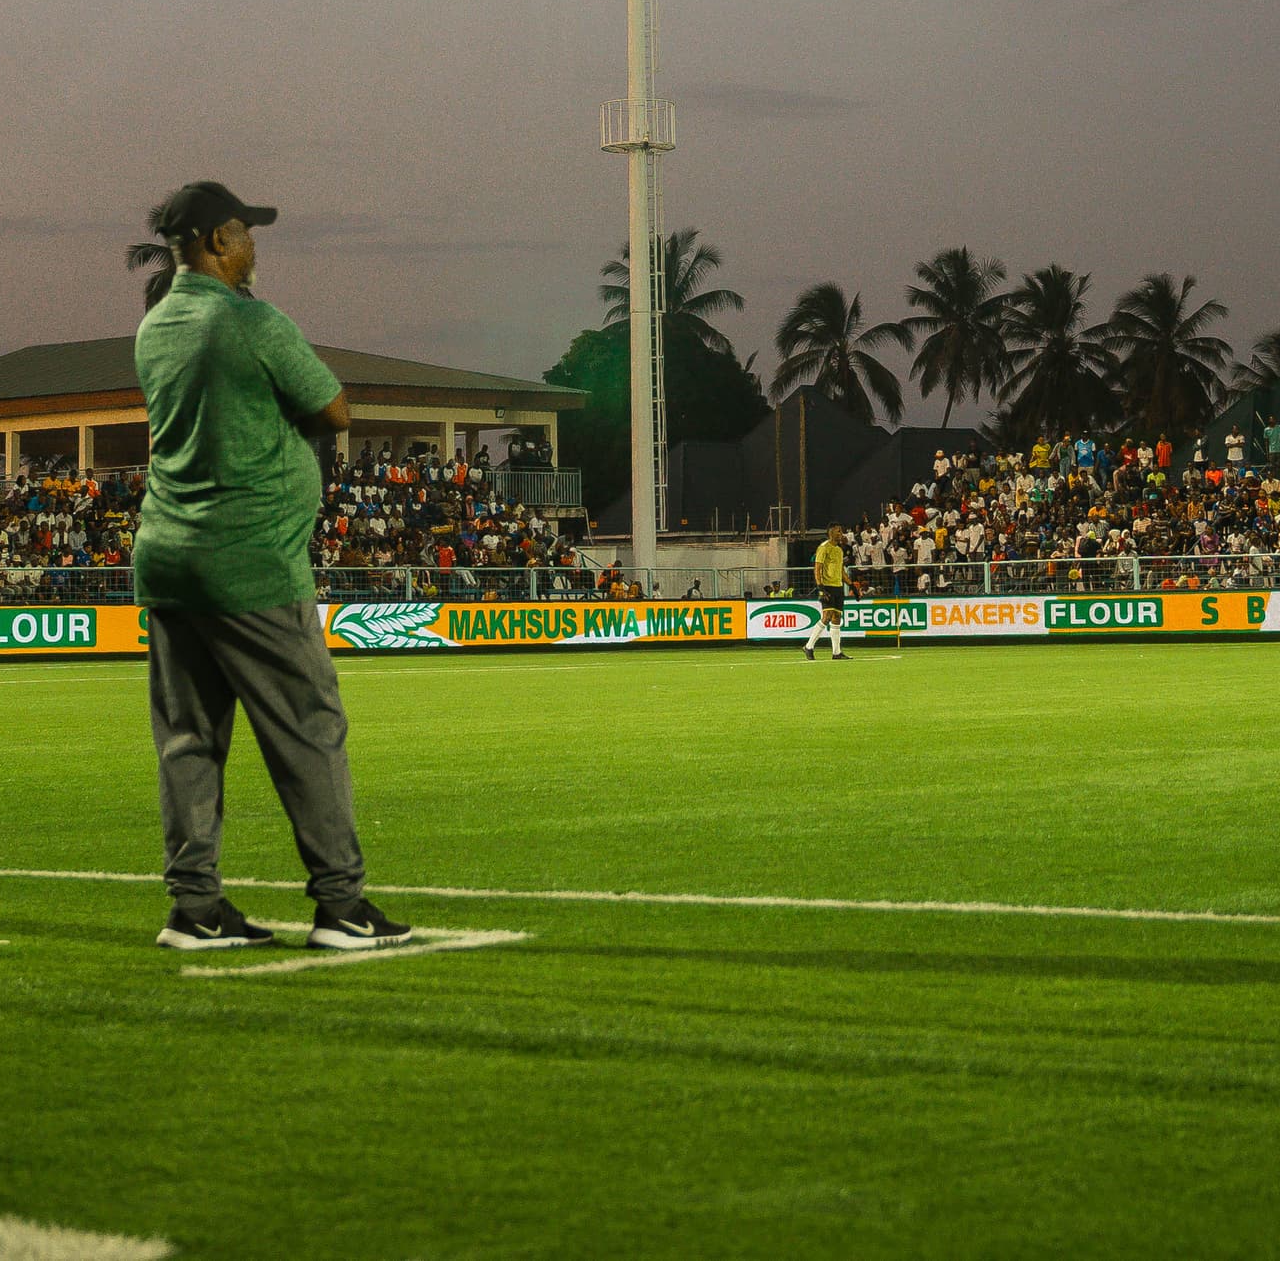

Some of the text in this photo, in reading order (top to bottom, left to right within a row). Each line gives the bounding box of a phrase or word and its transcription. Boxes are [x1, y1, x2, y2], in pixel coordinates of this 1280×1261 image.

[448, 607, 733, 640] MAKHSUS KWA MIKATE
[764, 613, 797, 628] azam
[829, 601, 1157, 628] PECIAL BAKER'S FLOUR
[1201, 597, 1219, 625] S
[1247, 596, 1266, 624] B
